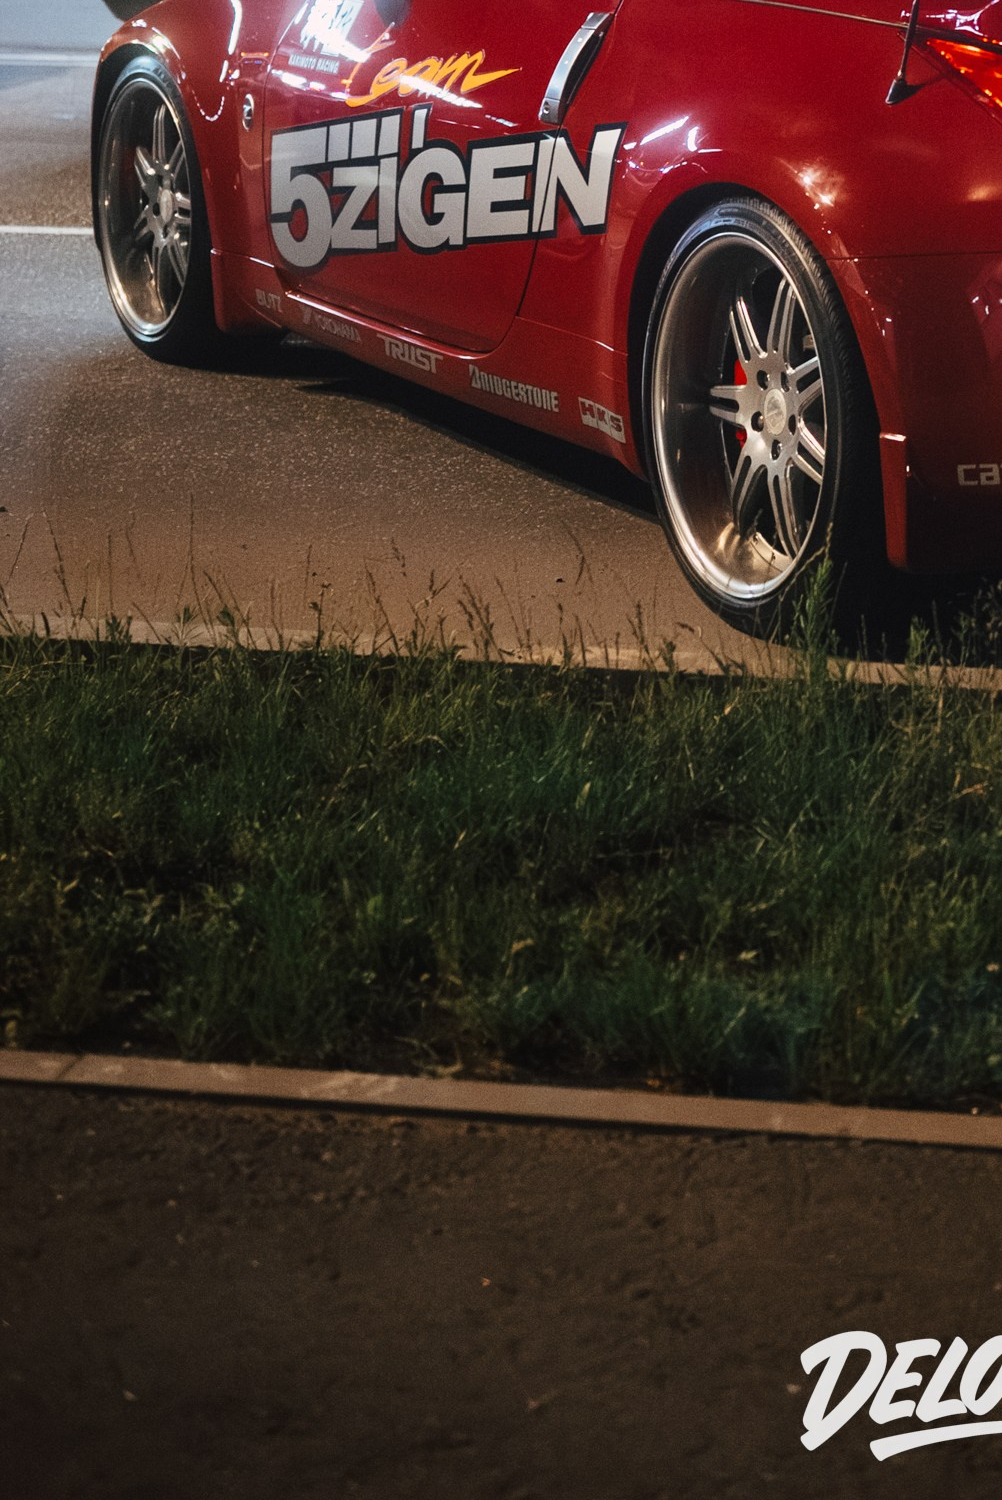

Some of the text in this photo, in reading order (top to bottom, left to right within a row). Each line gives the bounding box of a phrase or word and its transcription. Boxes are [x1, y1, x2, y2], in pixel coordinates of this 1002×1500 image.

[316, 58, 340, 74] RACING
[376, 333, 444, 374] TRUST
[469, 364, 560, 414] BRIDGESTONE
[579, 397, 625, 438] HKS
